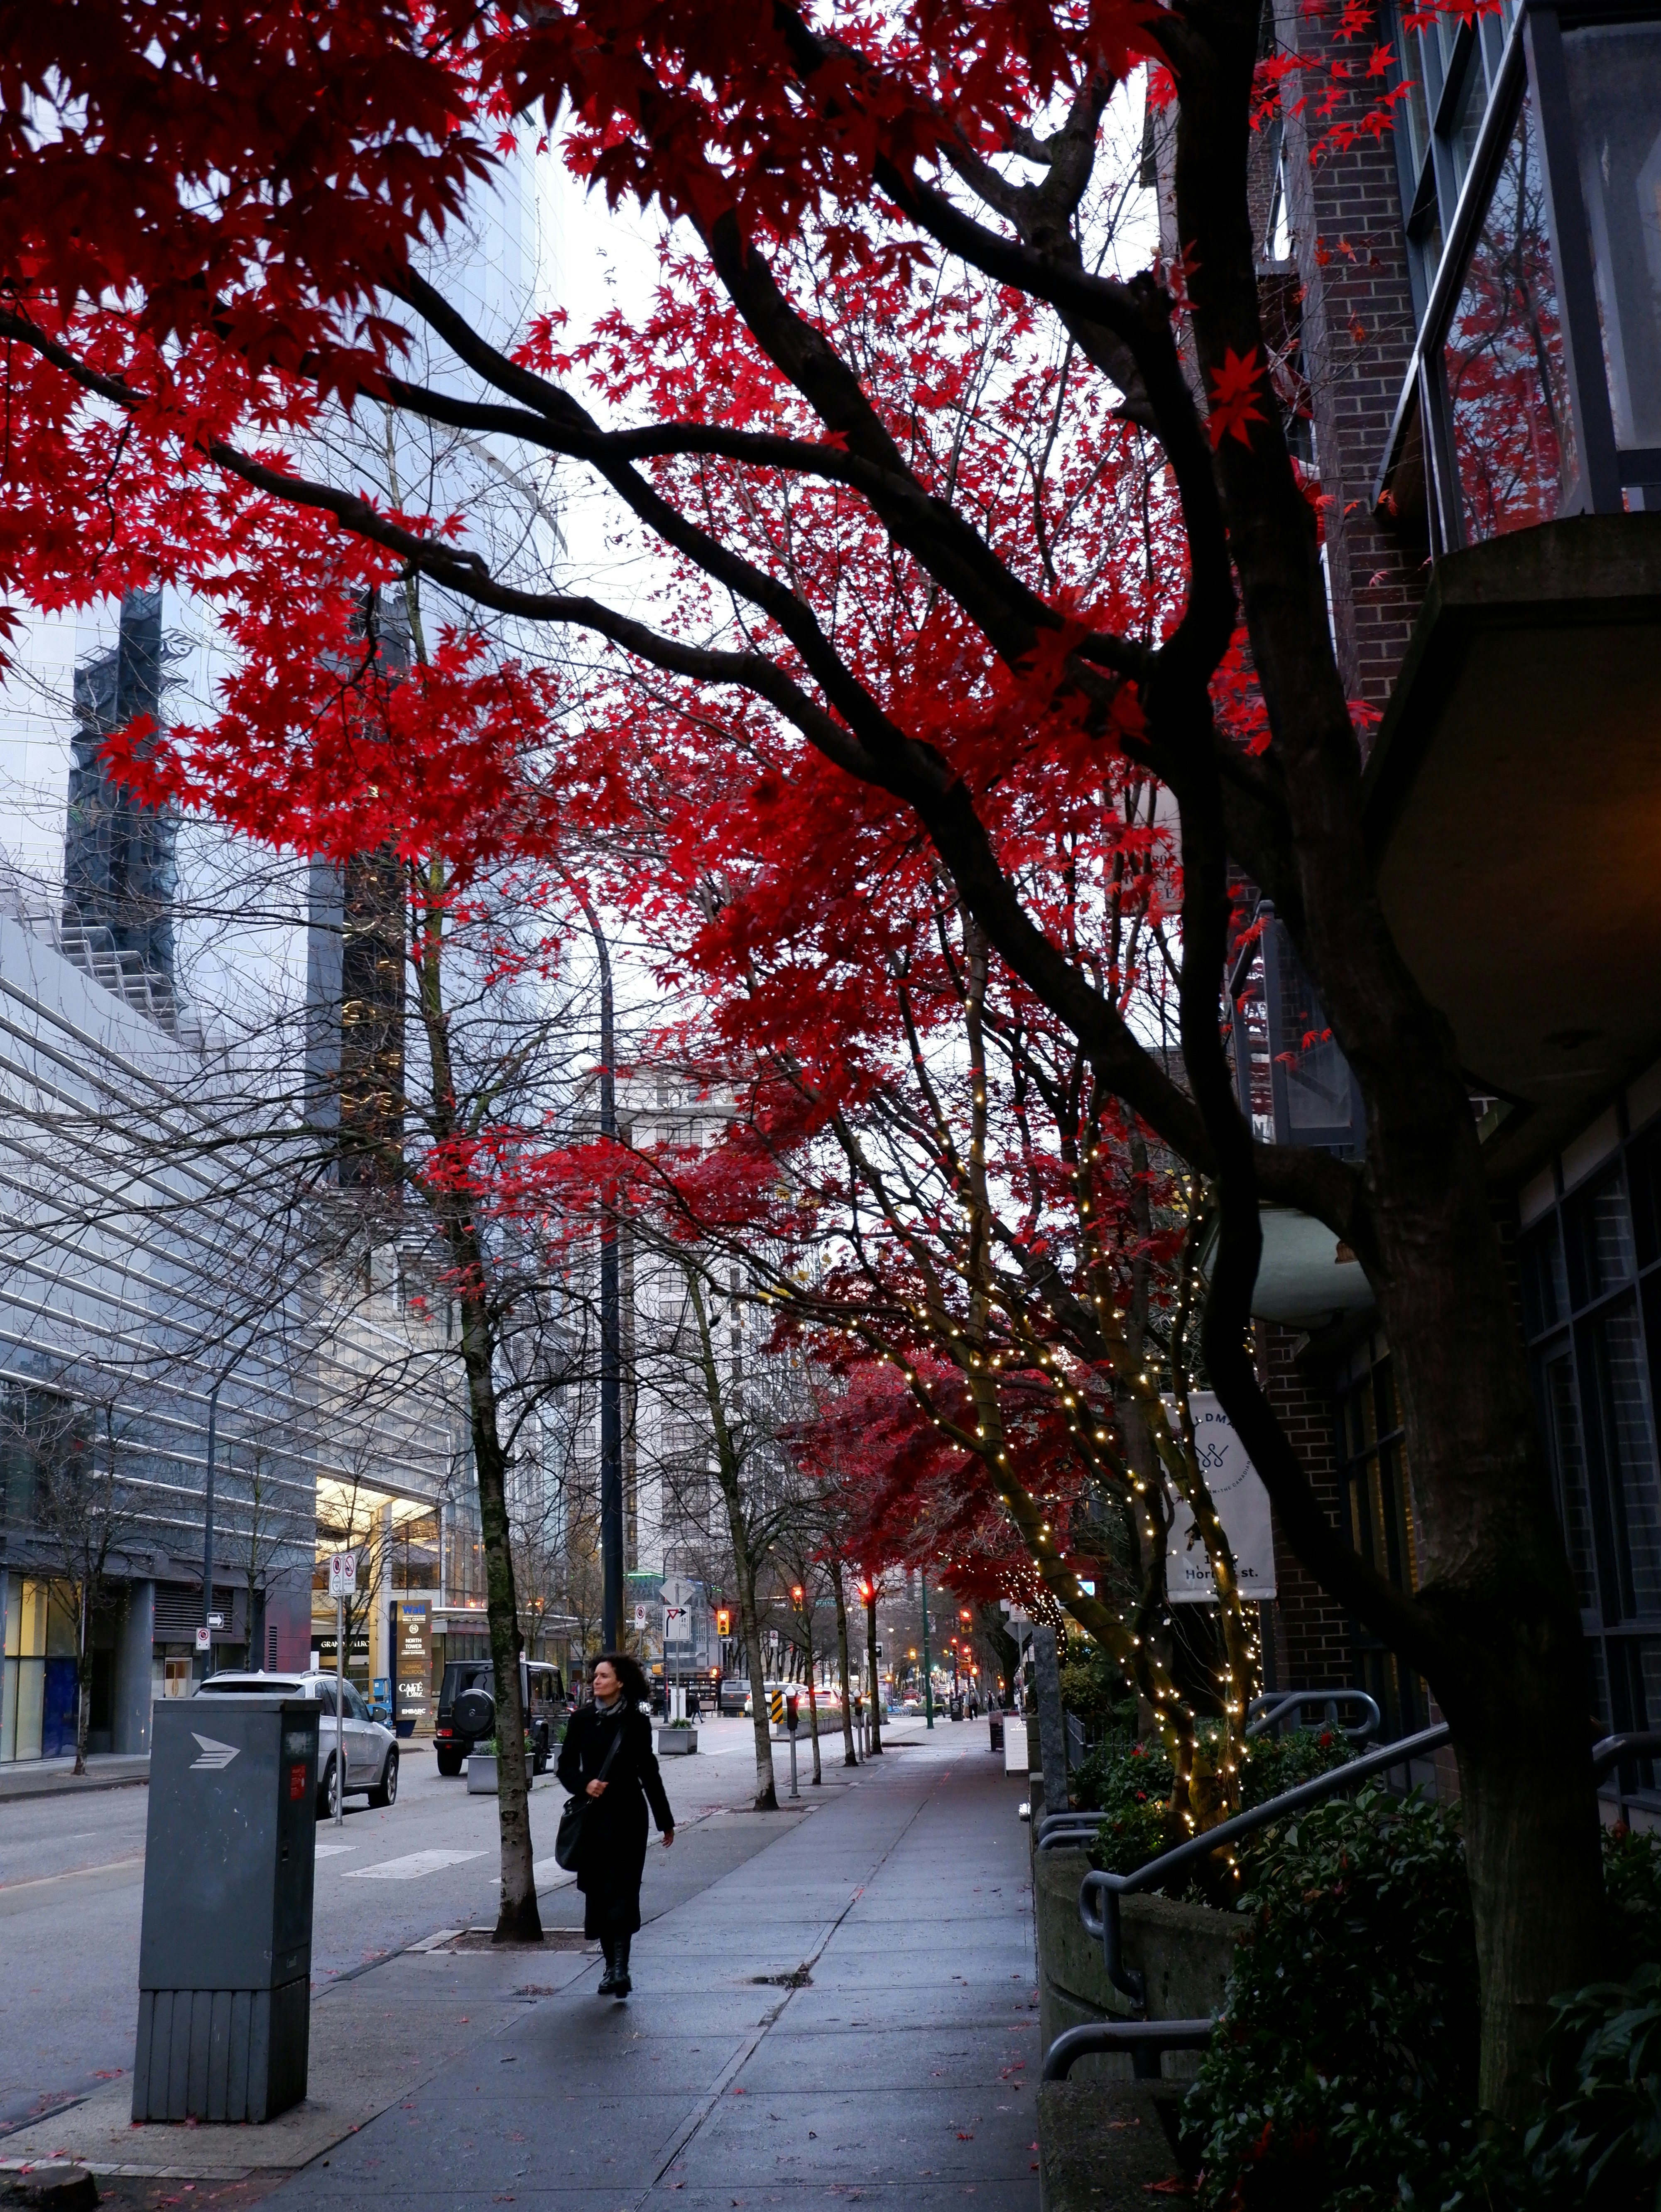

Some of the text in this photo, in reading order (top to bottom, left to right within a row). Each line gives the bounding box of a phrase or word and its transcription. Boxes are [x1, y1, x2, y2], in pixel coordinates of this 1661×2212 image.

[1241, 1568, 1258, 1578] st.
[402, 1604, 426, 1614] Wall
[399, 1681, 423, 1692] CAFÉ
